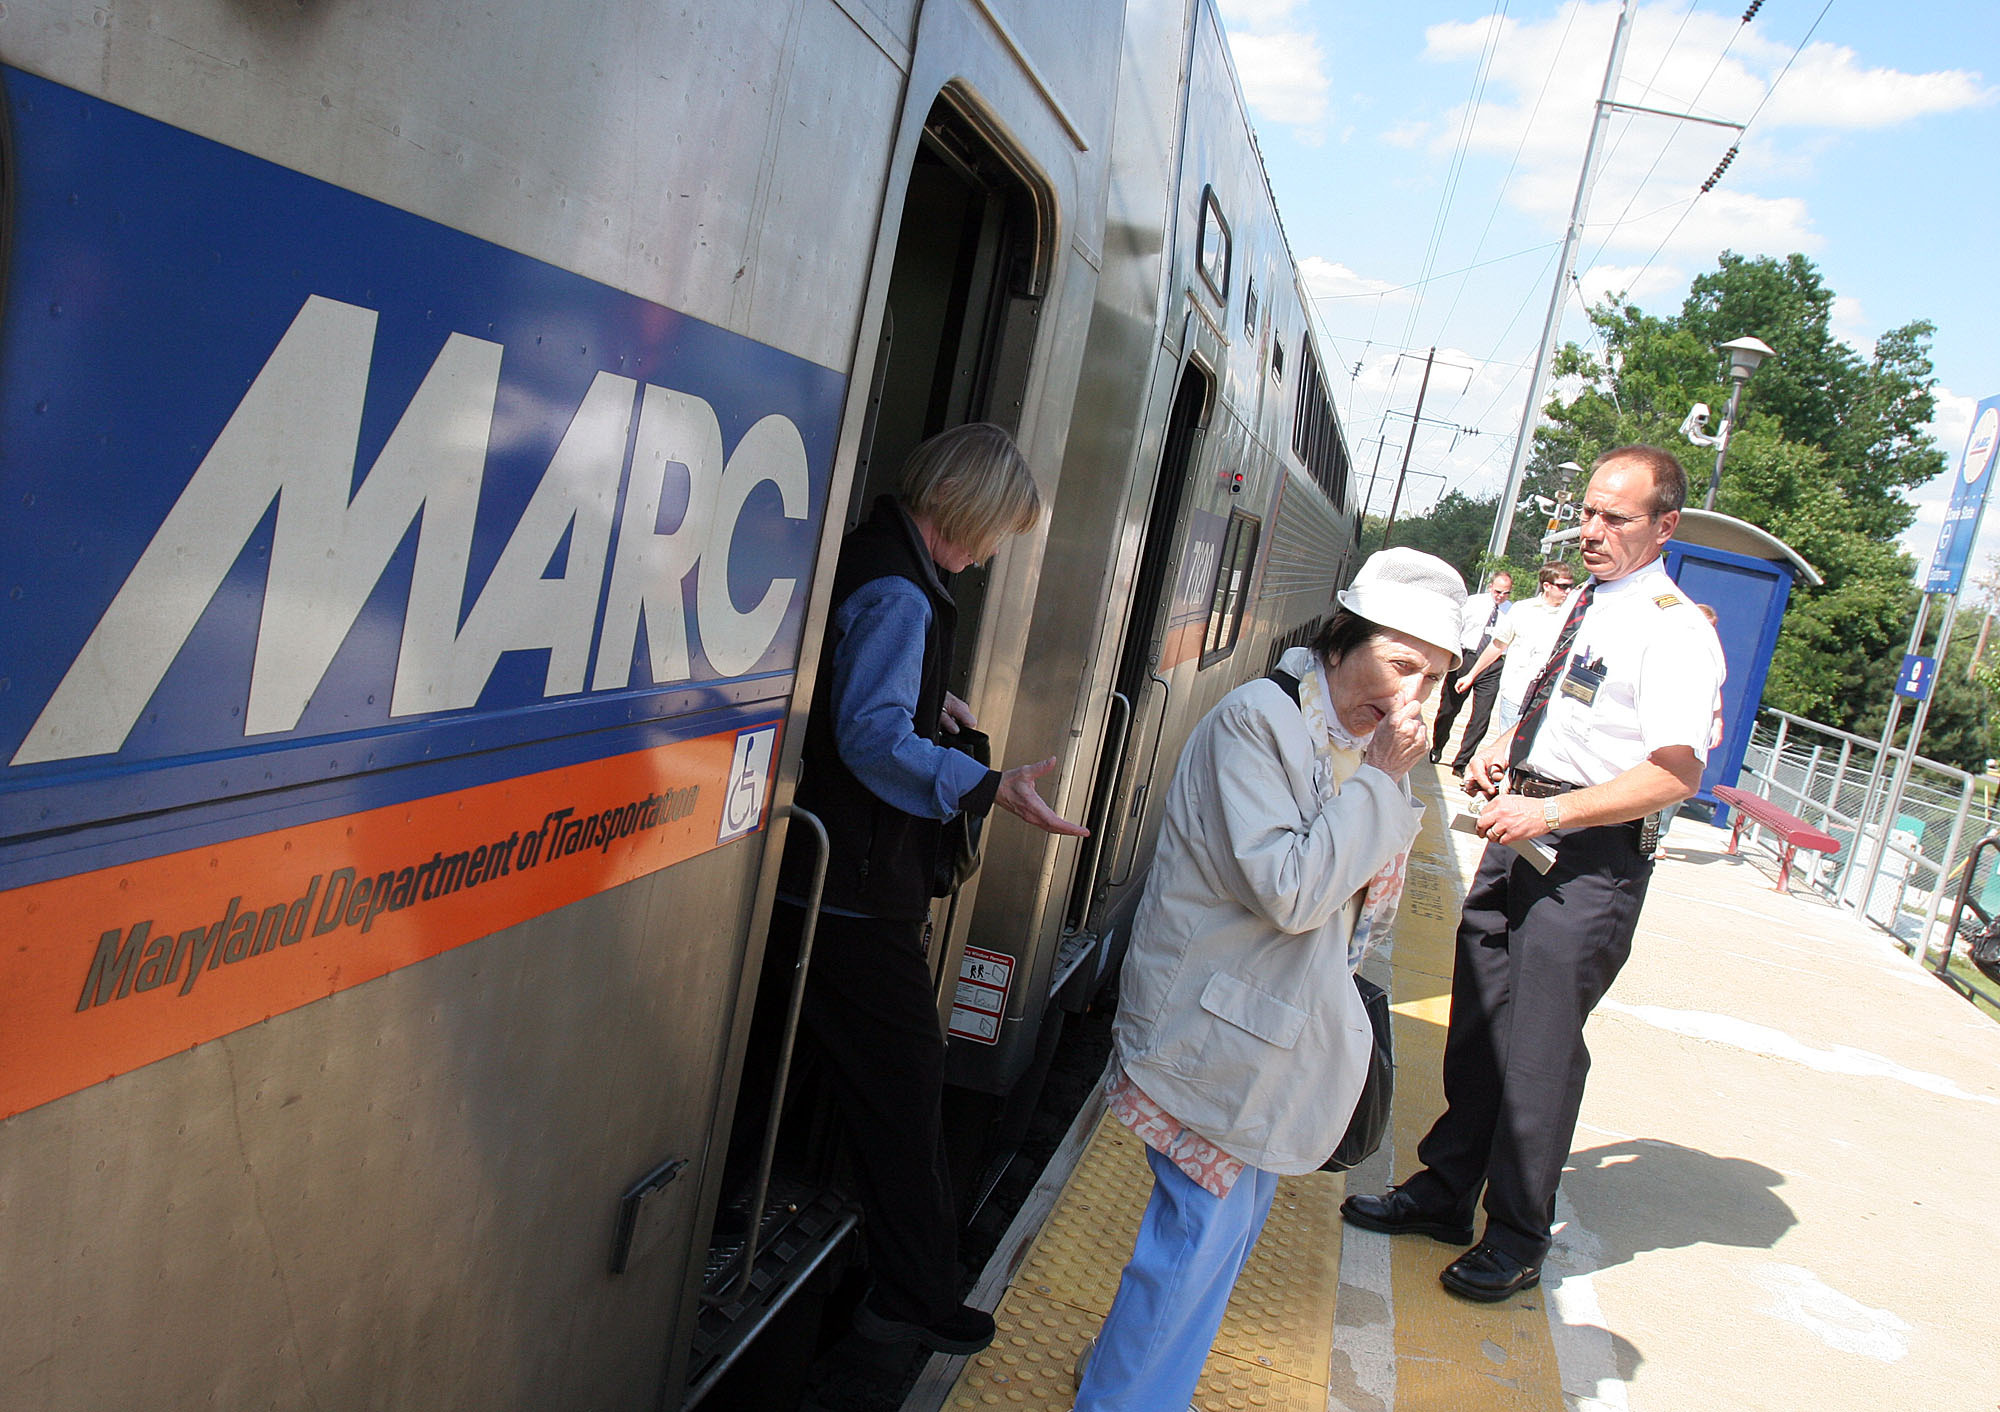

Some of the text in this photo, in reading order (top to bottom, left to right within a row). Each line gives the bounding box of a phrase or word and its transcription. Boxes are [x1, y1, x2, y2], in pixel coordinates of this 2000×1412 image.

[8, 293, 810, 766] MARC
[75, 784, 700, 1014] Maryland Department of Transportation
